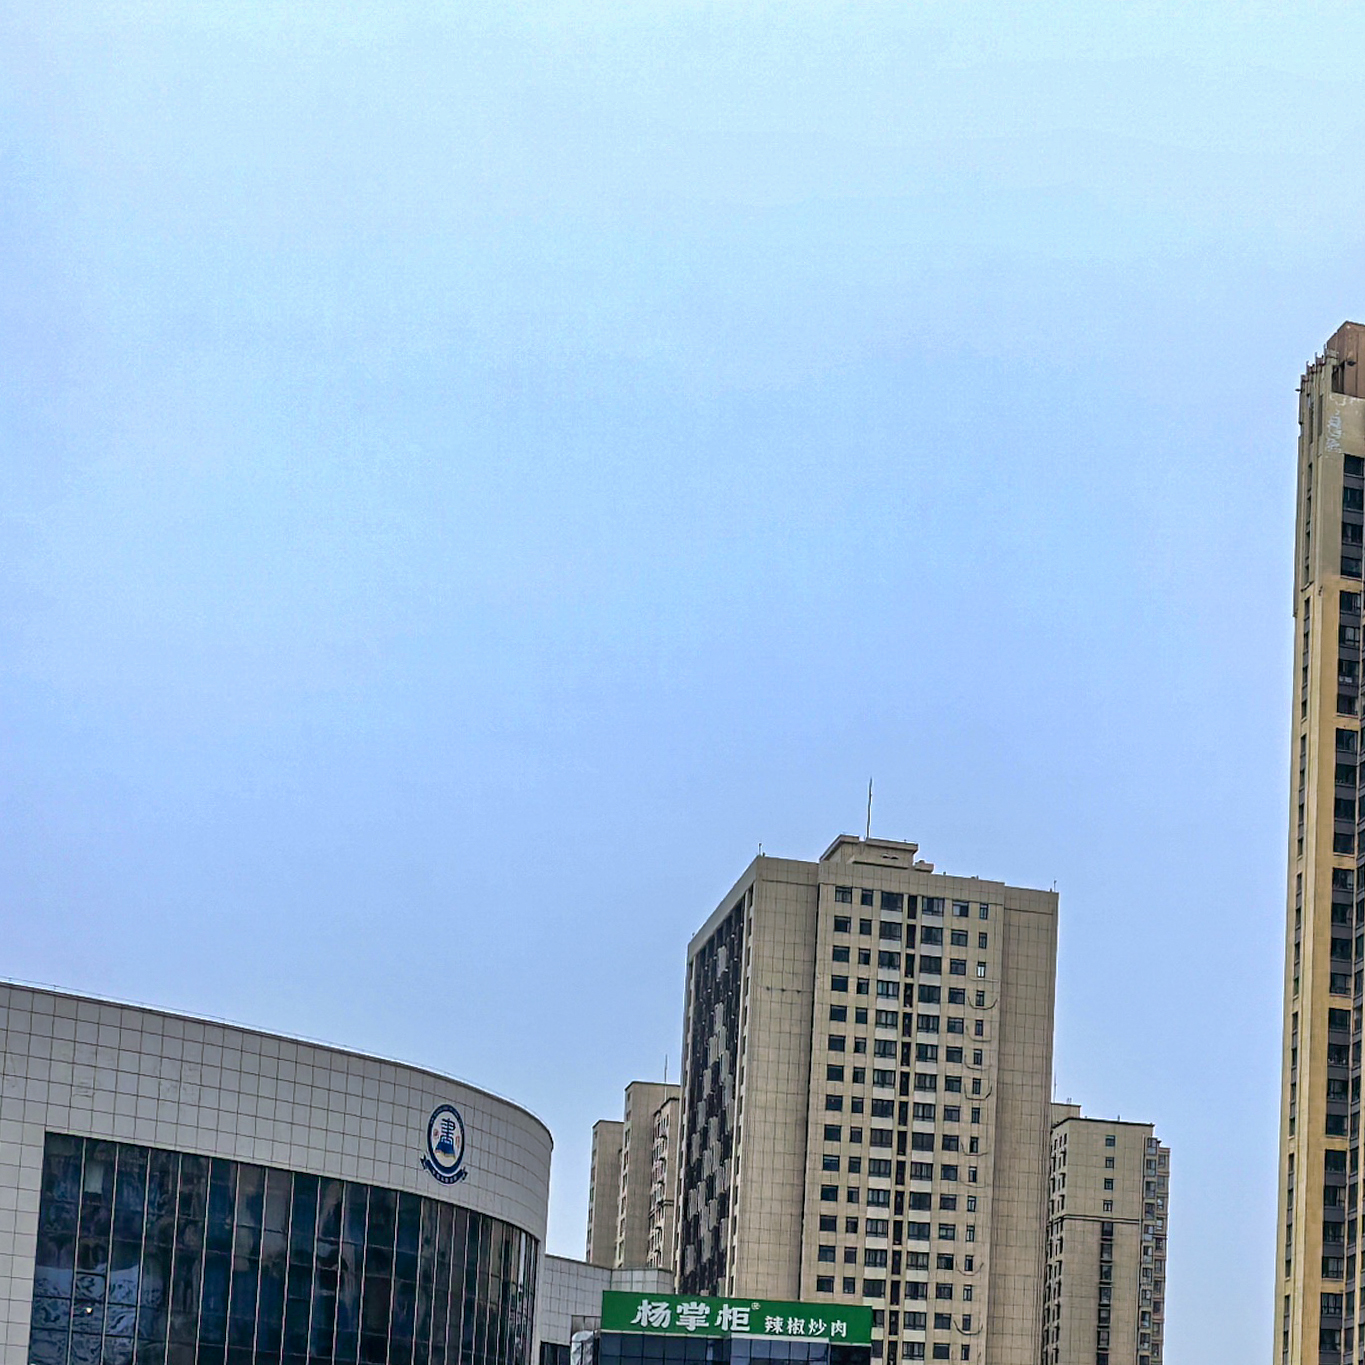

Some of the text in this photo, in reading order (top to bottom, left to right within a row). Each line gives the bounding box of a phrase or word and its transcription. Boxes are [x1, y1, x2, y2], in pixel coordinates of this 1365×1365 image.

[630, 1299, 848, 1338] 杨掌柜 辣椒炒肉
